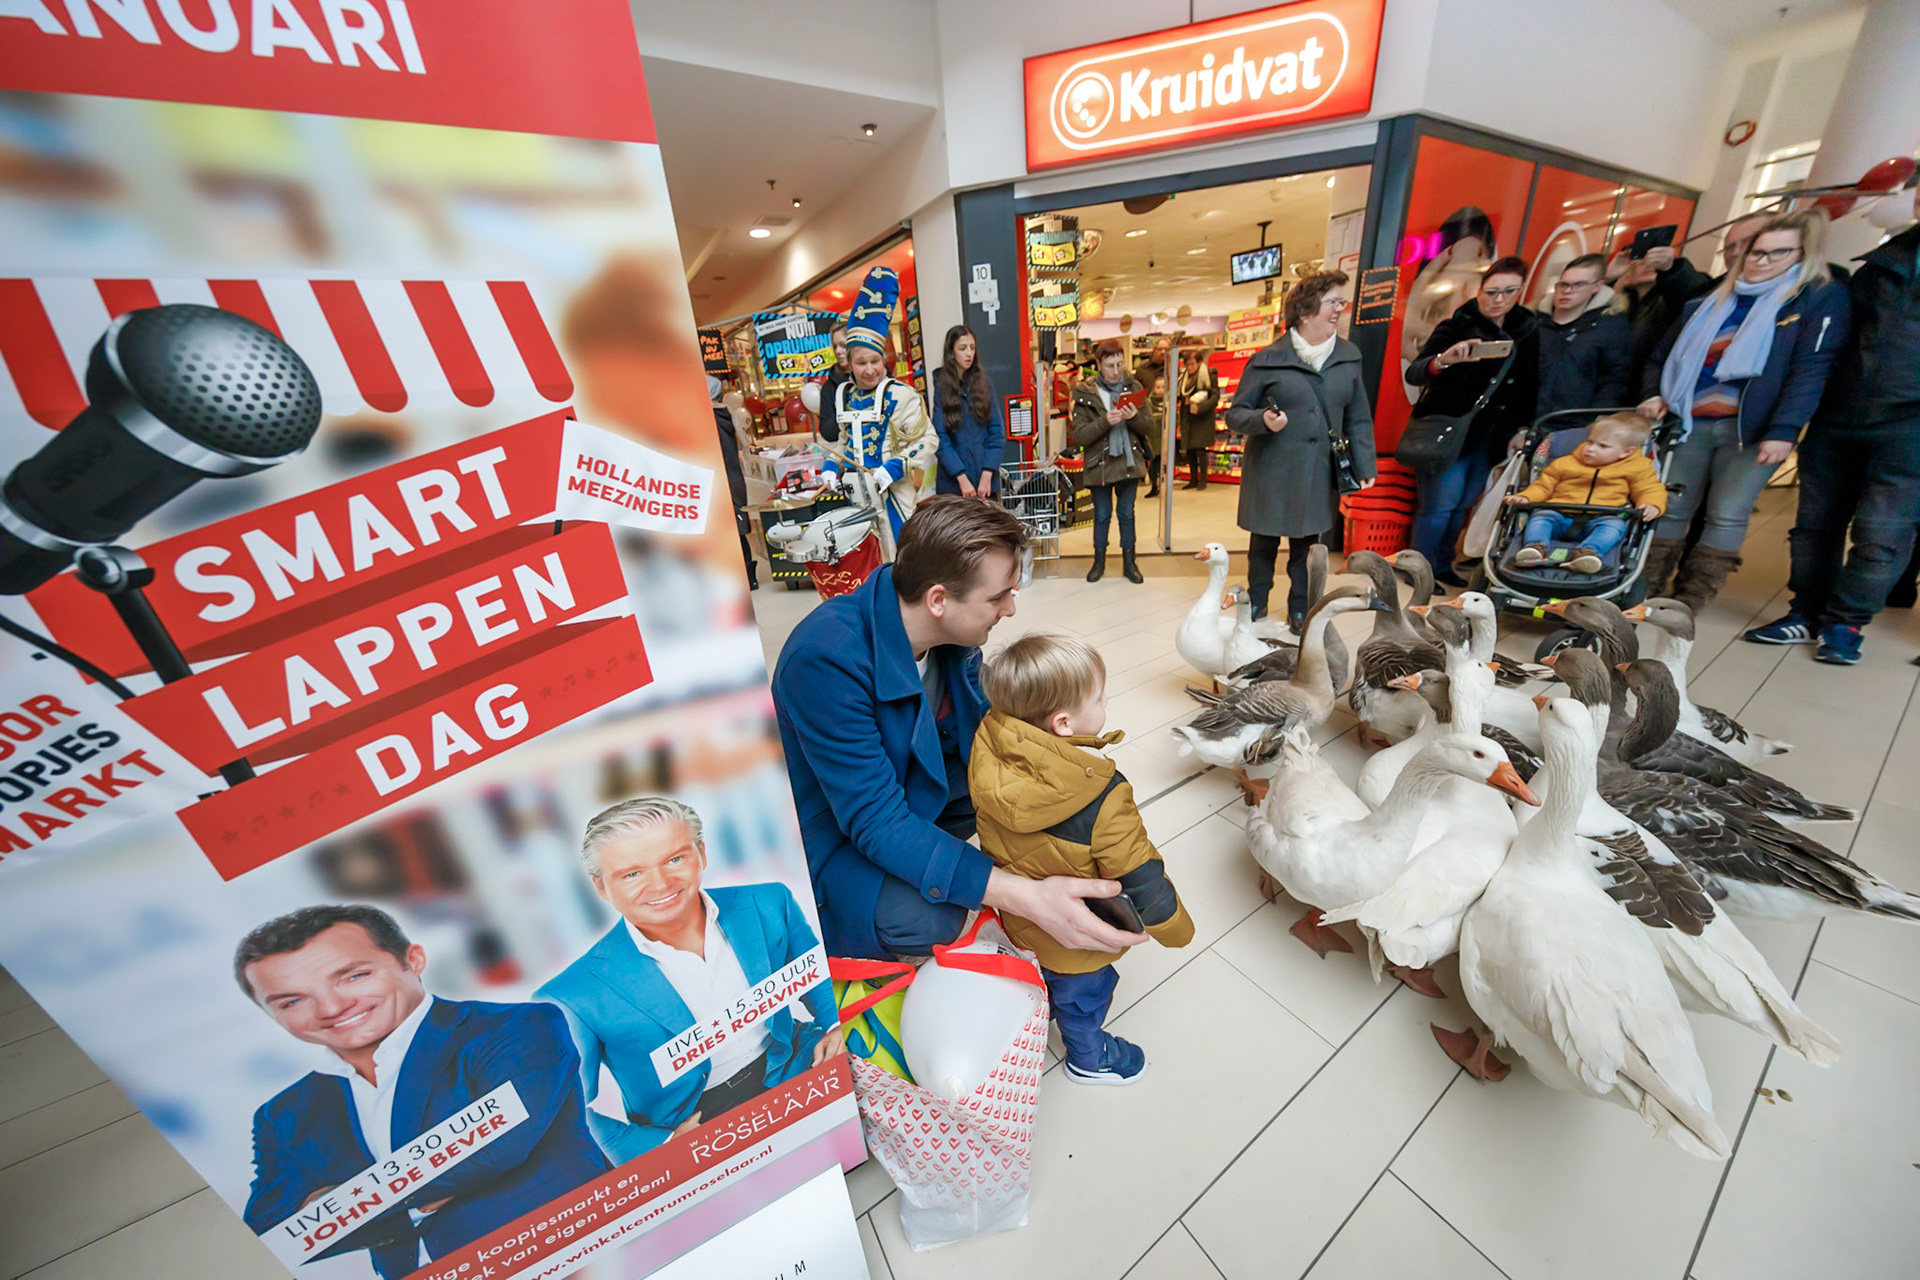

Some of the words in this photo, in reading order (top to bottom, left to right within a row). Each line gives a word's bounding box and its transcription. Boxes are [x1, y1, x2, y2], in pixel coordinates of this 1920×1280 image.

[1120, 36, 1324, 123] Kruidvat
[976, 266, 988, 280] 10
[764, 333, 832, 359] OPRUIMIN
[568, 475, 699, 520] MEEZINGERS
[576, 454, 700, 499] HOLLANDSE
[173, 446, 511, 623] SMART
[201, 552, 576, 749] LAPPEN
[0, 723, 120, 813] OPJES
[355, 683, 530, 797] DAG
[667, 1026, 704, 1058] LIVE
[725, 980, 776, 1019] 15.30
[781, 954, 817, 983] UUR
[672, 1030, 726, 1072] DRIES
[731, 967, 820, 1033] ROELVINK
[689, 1068, 837, 1148] WINKELCENTRUM
[691, 1077, 840, 1164] ROSELAAR
[285, 1197, 342, 1238] LIVE
[368, 1134, 442, 1184] 13.30
[449, 1098, 500, 1134] UUR
[302, 1192, 383, 1252] JOHN
[388, 1167, 423, 1194] DE
[428, 1114, 508, 1168] BEVER
[477, 1186, 611, 1262] koopjesmarkt
[617, 1174, 639, 1189] en
[501, 1245, 538, 1267] van
[545, 1212, 597, 1244] eigen
[603, 1170, 671, 1213] bodem!
